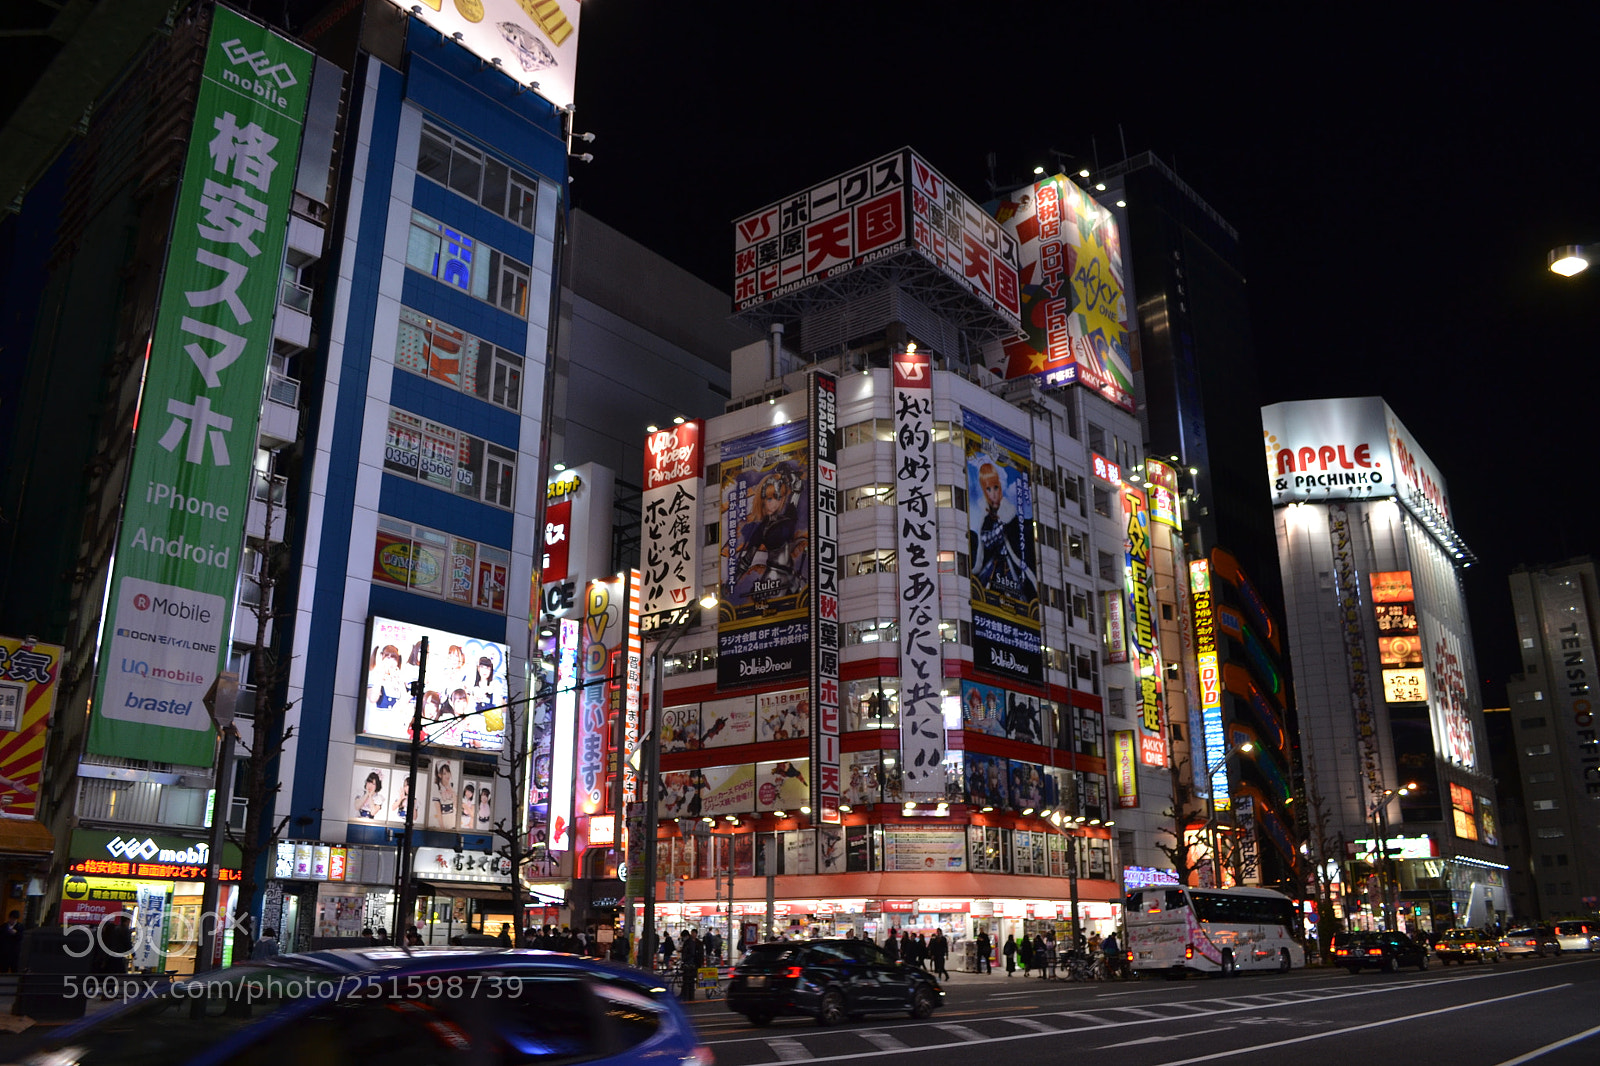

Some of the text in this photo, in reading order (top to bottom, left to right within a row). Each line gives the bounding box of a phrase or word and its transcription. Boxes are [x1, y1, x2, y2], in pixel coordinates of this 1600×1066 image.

[223, 67, 288, 109] mobile
[782, 155, 903, 231] ボークス
[914, 189, 960, 247] 秋葉原
[947, 189, 1017, 267] ボークス
[736, 189, 903, 301] ホビー 天国
[737, 229, 801, 275] 秋葉原
[735, 242, 907, 311] VOLKS AKIHABARA HOBBY PARADISE
[915, 220, 1019, 314] ホビー 天国
[1036, 185, 1070, 362] 免税店 DUTY FREE
[158, 110, 280, 466] 格安スマホ
[1099, 304, 1117, 324] ONE
[817, 376, 828, 458] PARADISE
[826, 380, 836, 436] HOBBY
[385, 446, 472, 485] 0356 8568 05
[1276, 443, 1381, 475] APPLE.
[1275, 471, 1383, 490] & PACHINKO
[146, 482, 230, 522] iPhone
[130, 527, 230, 569] Android
[996, 572, 1018, 589] Saber
[1125, 492, 1154, 650] TAX FREE
[540, 582, 575, 614] CE
[754, 579, 781, 593] Ruler
[1194, 592, 1210, 601] ゲーム
[152, 596, 211, 623] Mobile
[1195, 600, 1210, 610] CD
[758, 629, 770, 640] 8F
[1003, 624, 1012, 636] 8F
[1196, 617, 1213, 627] アニメ
[130, 630, 217, 654] OCN モバイル ONE
[0, 646, 53, 684] 気
[121, 658, 204, 685] UQ mobile
[760, 694, 787, 706] 11.18
[1202, 668, 1219, 705] DVD
[124, 692, 193, 717] brastel
[1121, 749, 1130, 768] TAX
[1142, 738, 1164, 753] AKKY
[1145, 751, 1164, 766] ONE
[1122, 769, 1132, 795] FREE
[159, 843, 209, 865] mobil
[77, 903, 106, 914] iPhone
